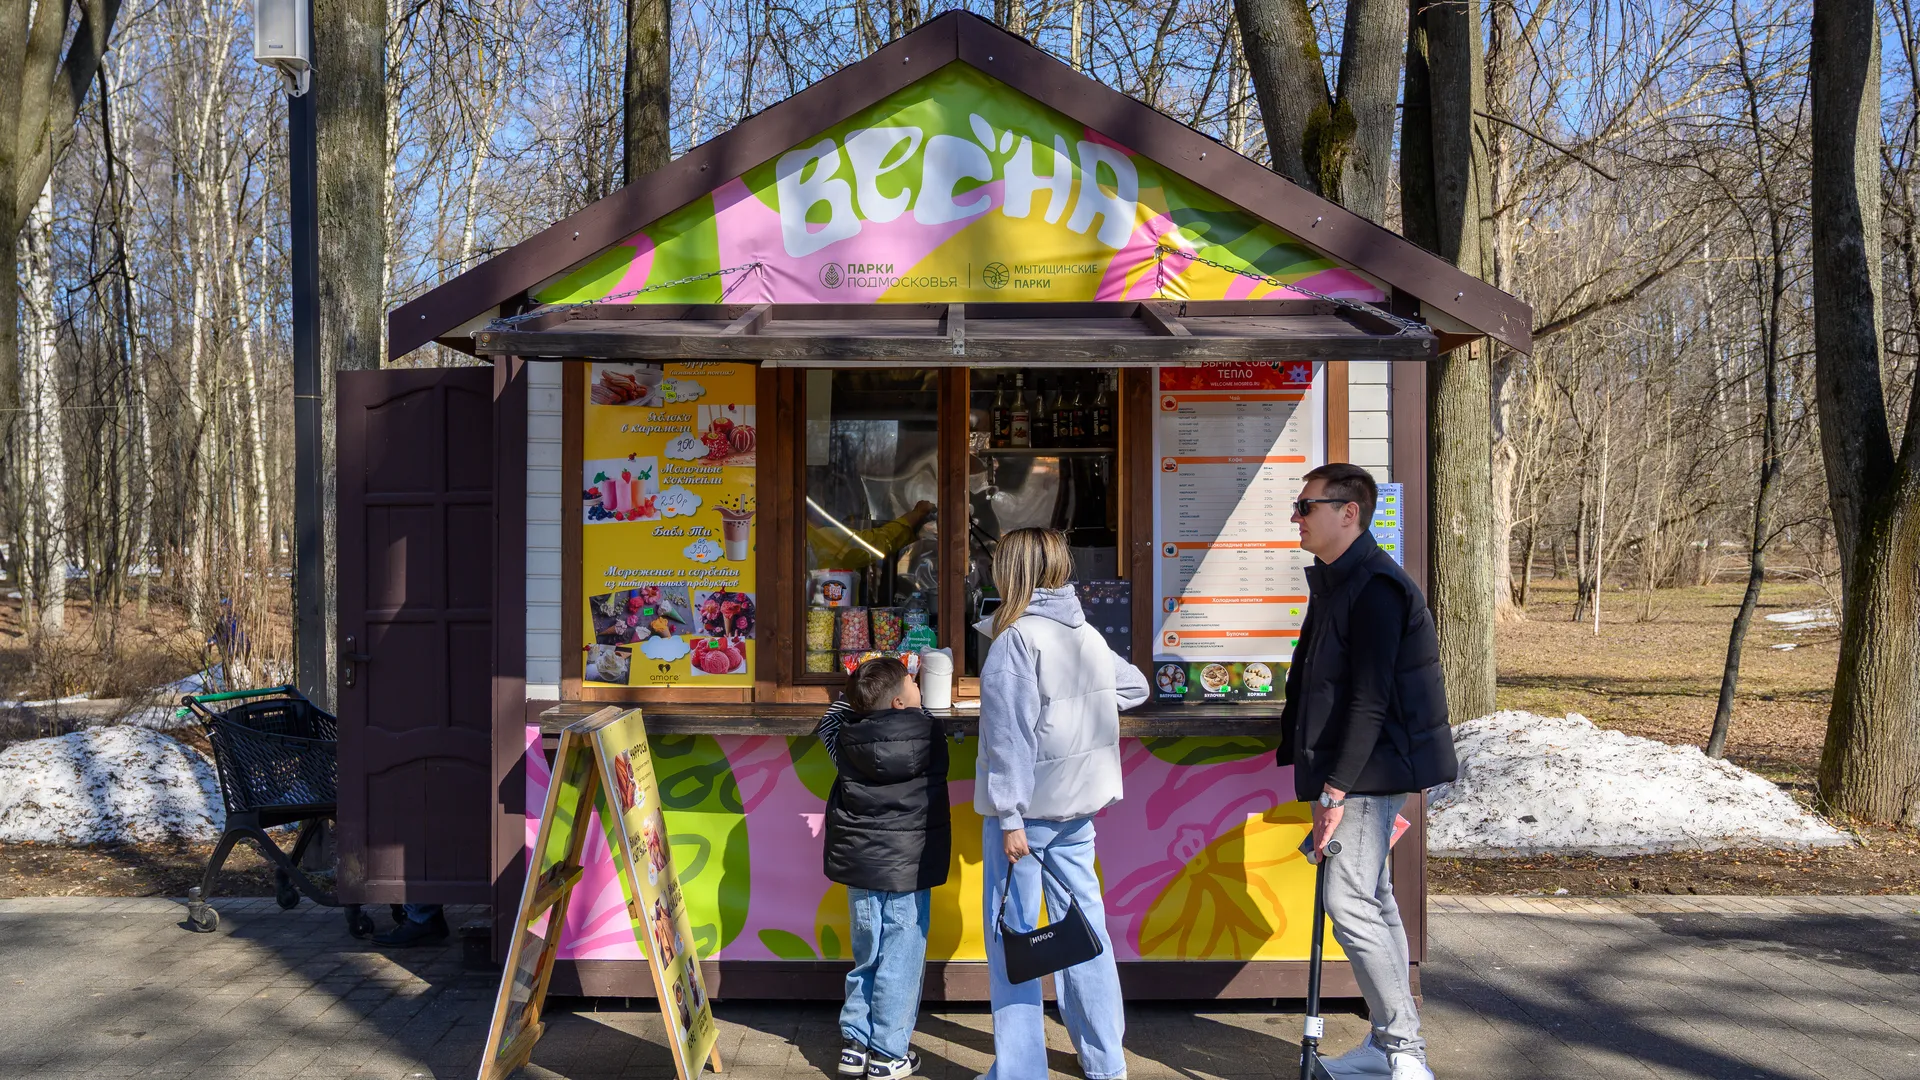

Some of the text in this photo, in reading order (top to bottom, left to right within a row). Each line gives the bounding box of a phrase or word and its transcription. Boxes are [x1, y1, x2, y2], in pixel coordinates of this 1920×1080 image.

[847, 263, 894, 274] ПАРКИ
[1014, 264, 1098, 275] МЫТИЩИНСКИЕ
[847, 276, 957, 288] ПОДМОСКОВЬЯ
[1014, 279, 1051, 288] ПАРКИ
[1218, 369, 1253, 379] ТЕПЛО
[647, 411, 691, 422] Яблоко
[621, 424, 691, 435] в карамели
[660, 463, 723, 473] Молочные
[663, 475, 722, 484] коктейли
[651, 526, 711, 536] Бабл Ти
[604, 566, 674, 579] Мороженое
[688, 566, 739, 579] сорбеты
[604, 580, 739, 588] из натуральных продуктов
[1032, 931, 1054, 944] HUGO
[841, 1055, 854, 1063] FILA
[868, 1066, 880, 1074] FILA
